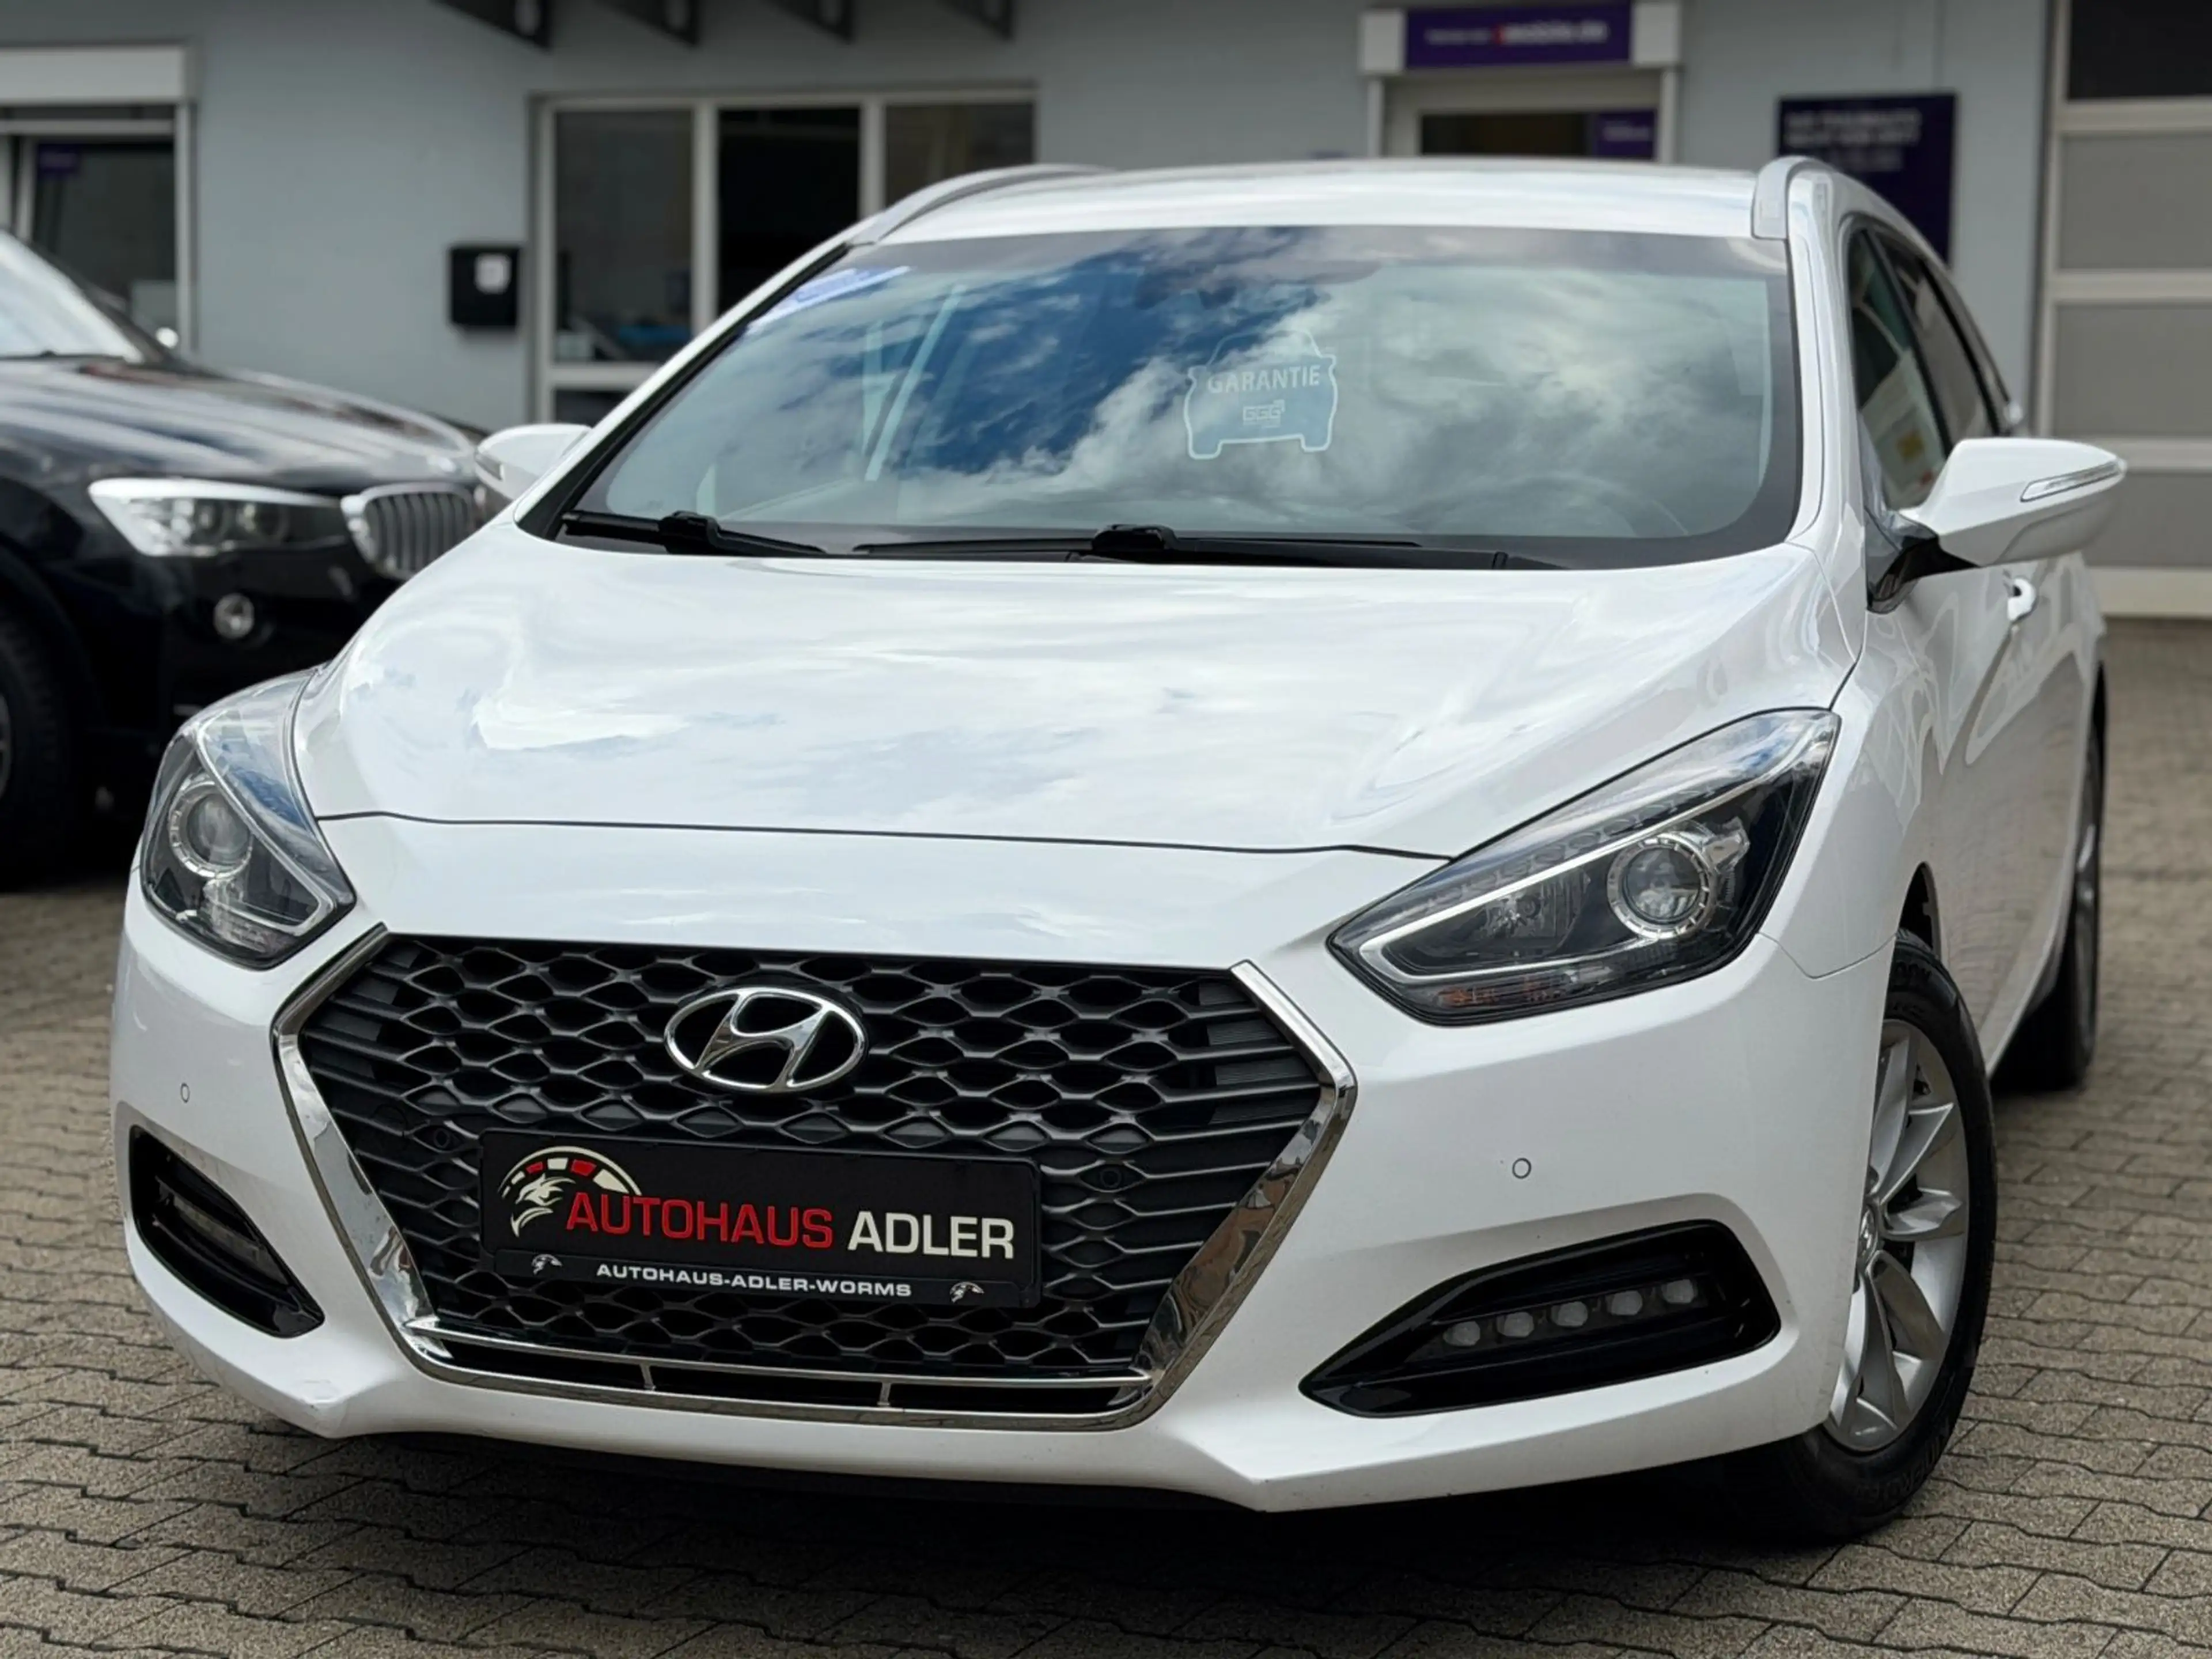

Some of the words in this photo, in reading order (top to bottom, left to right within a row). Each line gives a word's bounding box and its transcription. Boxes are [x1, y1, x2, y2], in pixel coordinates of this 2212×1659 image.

[1207, 364, 1321, 393] GARANTIE
[566, 1191, 834, 1249] AUTOHAUS
[847, 1211, 1014, 1260] ADLER
[596, 1263, 912, 1297] AUTOHAUS-ADLER-WORMS
